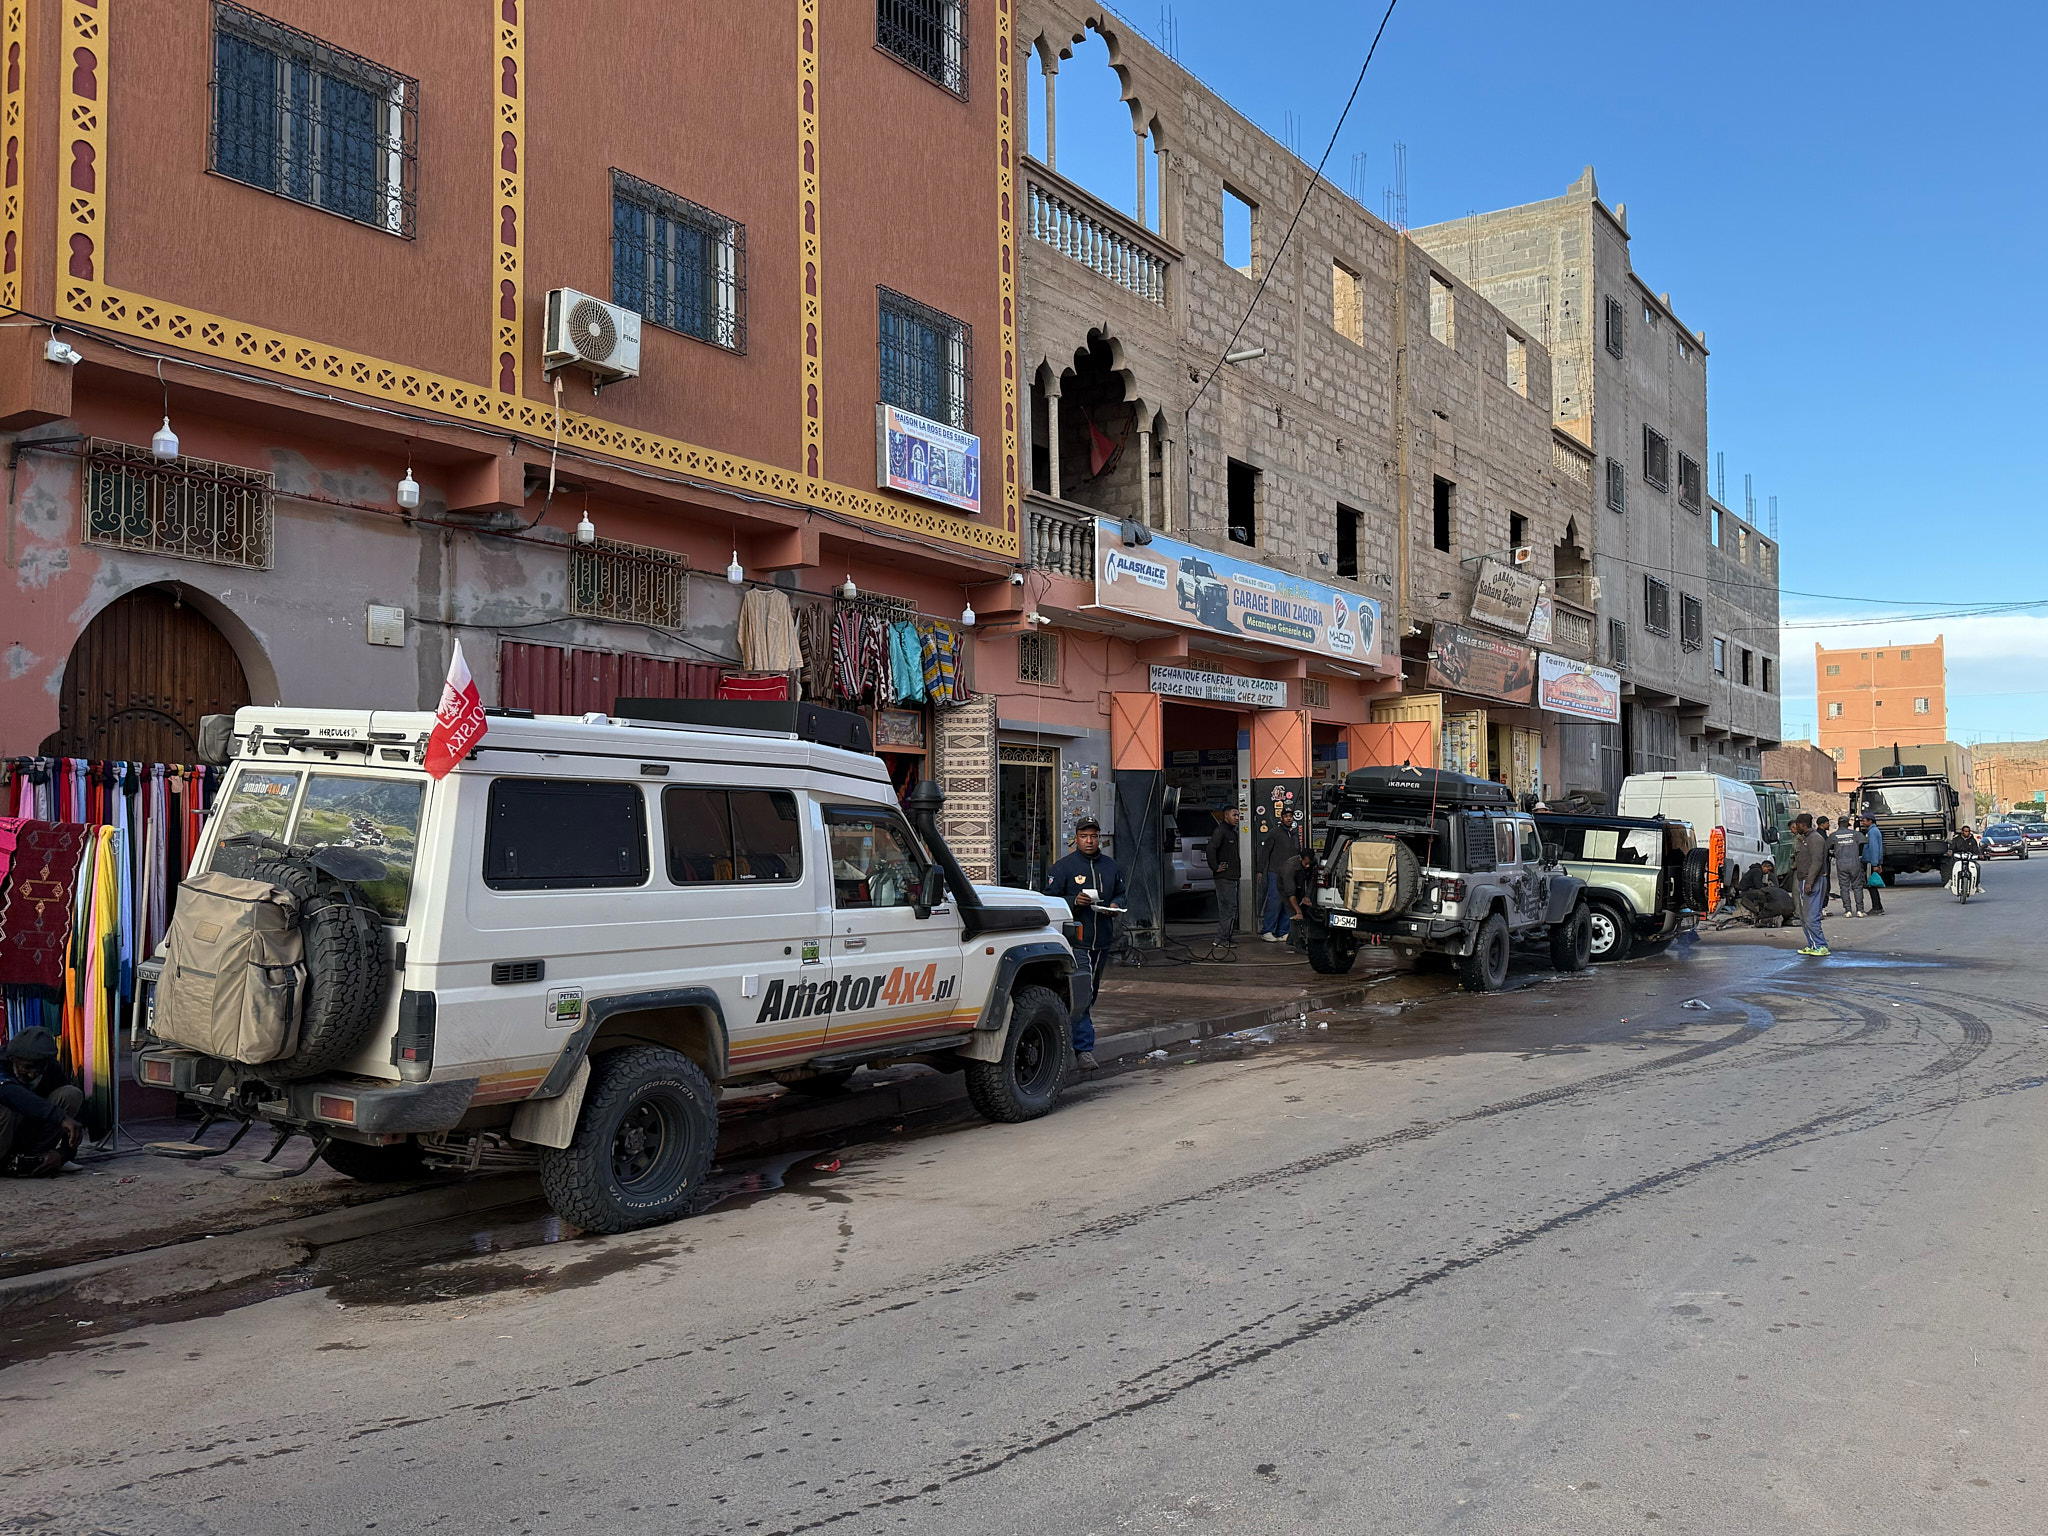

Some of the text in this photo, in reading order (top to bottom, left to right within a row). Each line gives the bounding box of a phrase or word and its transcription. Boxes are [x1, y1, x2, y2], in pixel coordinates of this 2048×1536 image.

[894, 411, 918, 428] MAISON
[919, 421, 927, 432] LA
[927, 424, 942, 437] ROSE
[943, 429, 953, 440] DES
[954, 433, 974, 447] SABLES
[1492, 571, 1516, 592] GARAGE
[1479, 580, 1502, 600] Sahara
[1502, 588, 1523, 608] Zagora
[1233, 588, 1269, 613] GARAGE
[1271, 598, 1291, 618] IRIKI
[1293, 603, 1323, 627] ZAGORA
[1247, 616, 1277, 632] Mécanique
[1456, 634, 1478, 648] GARAGE
[1545, 656, 1566, 667] Team
[1201, 673, 1234, 687] GENERAL
[1251, 680, 1279, 692] ZAGORA
[1151, 681, 1183, 694] GARAGE
[1184, 685, 1203, 697] IRIKI
[1237, 691, 1255, 702] CHEZ
[1257, 694, 1274, 705] AZIZ
[1547, 696, 1570, 706] Garage
[242, 781, 291, 796] amator4x4.pl
[141, 970, 159, 979] TOYOT
[560, 992, 580, 1000] PETROL
[755, 963, 956, 1024] Amator4x4.pl
